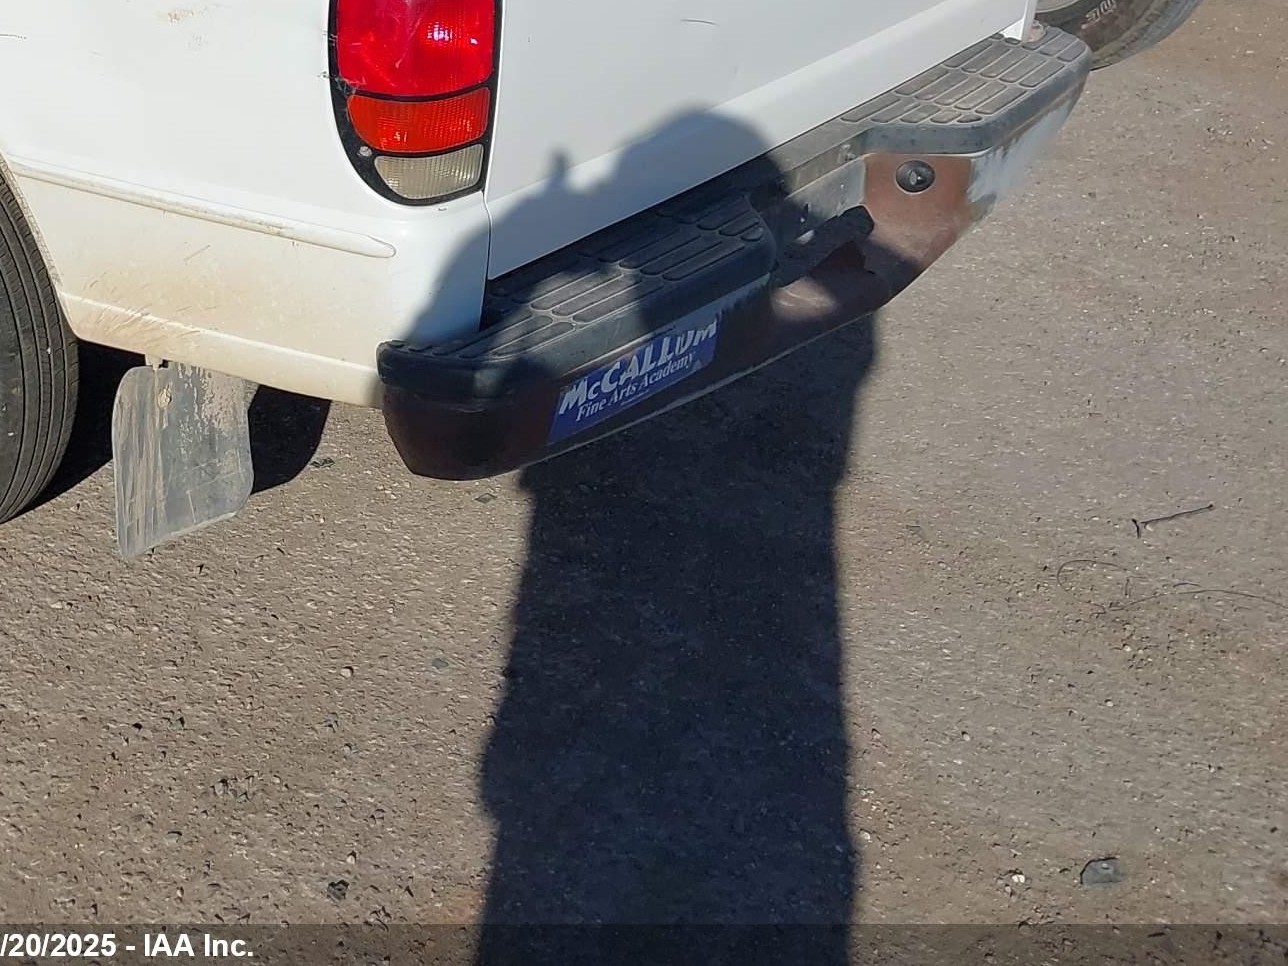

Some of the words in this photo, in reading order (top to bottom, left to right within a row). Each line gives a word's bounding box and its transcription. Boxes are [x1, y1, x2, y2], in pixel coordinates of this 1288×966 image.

[575, 398, 608, 422] Fine
[609, 381, 637, 406] Arts
[636, 350, 697, 389] Academy
